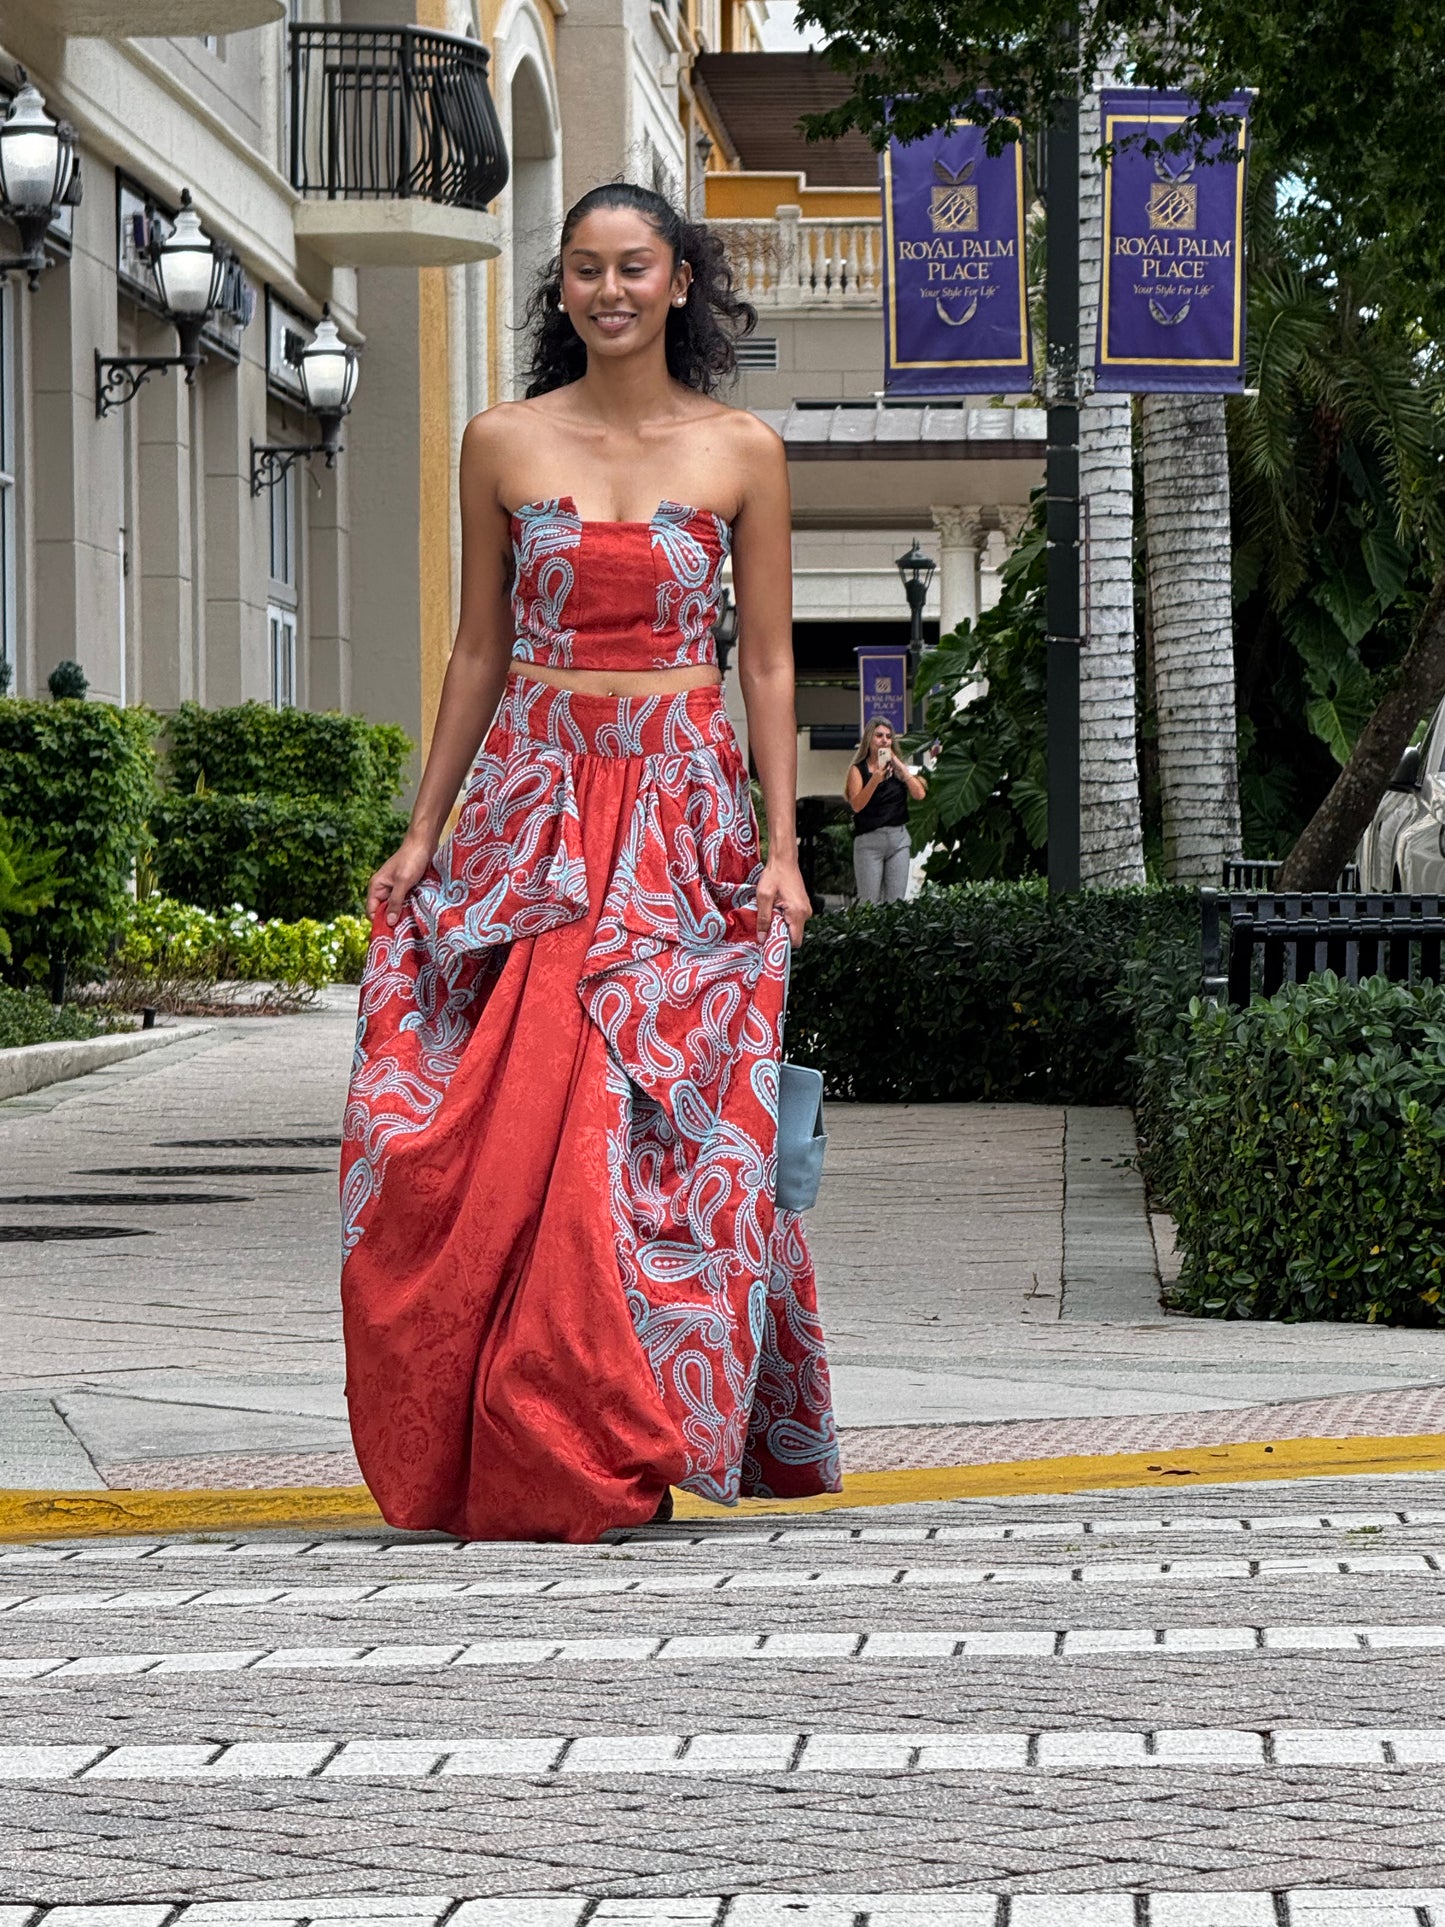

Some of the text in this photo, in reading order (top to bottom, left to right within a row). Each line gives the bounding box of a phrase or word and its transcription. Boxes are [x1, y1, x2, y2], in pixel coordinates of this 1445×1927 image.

[899, 238, 1014, 260] ROYAL PALM
[1114, 235, 1231, 257] ROYAL PALM
[928, 262, 990, 280] PLACE
[1142, 259, 1204, 278] PLACE
[920, 287, 940, 298] Your
[942, 287, 962, 300] Style
[964, 286, 979, 297] For
[1133, 284, 1153, 294] Your
[1155, 284, 1176, 297] Style
[1177, 285, 1193, 295] For
